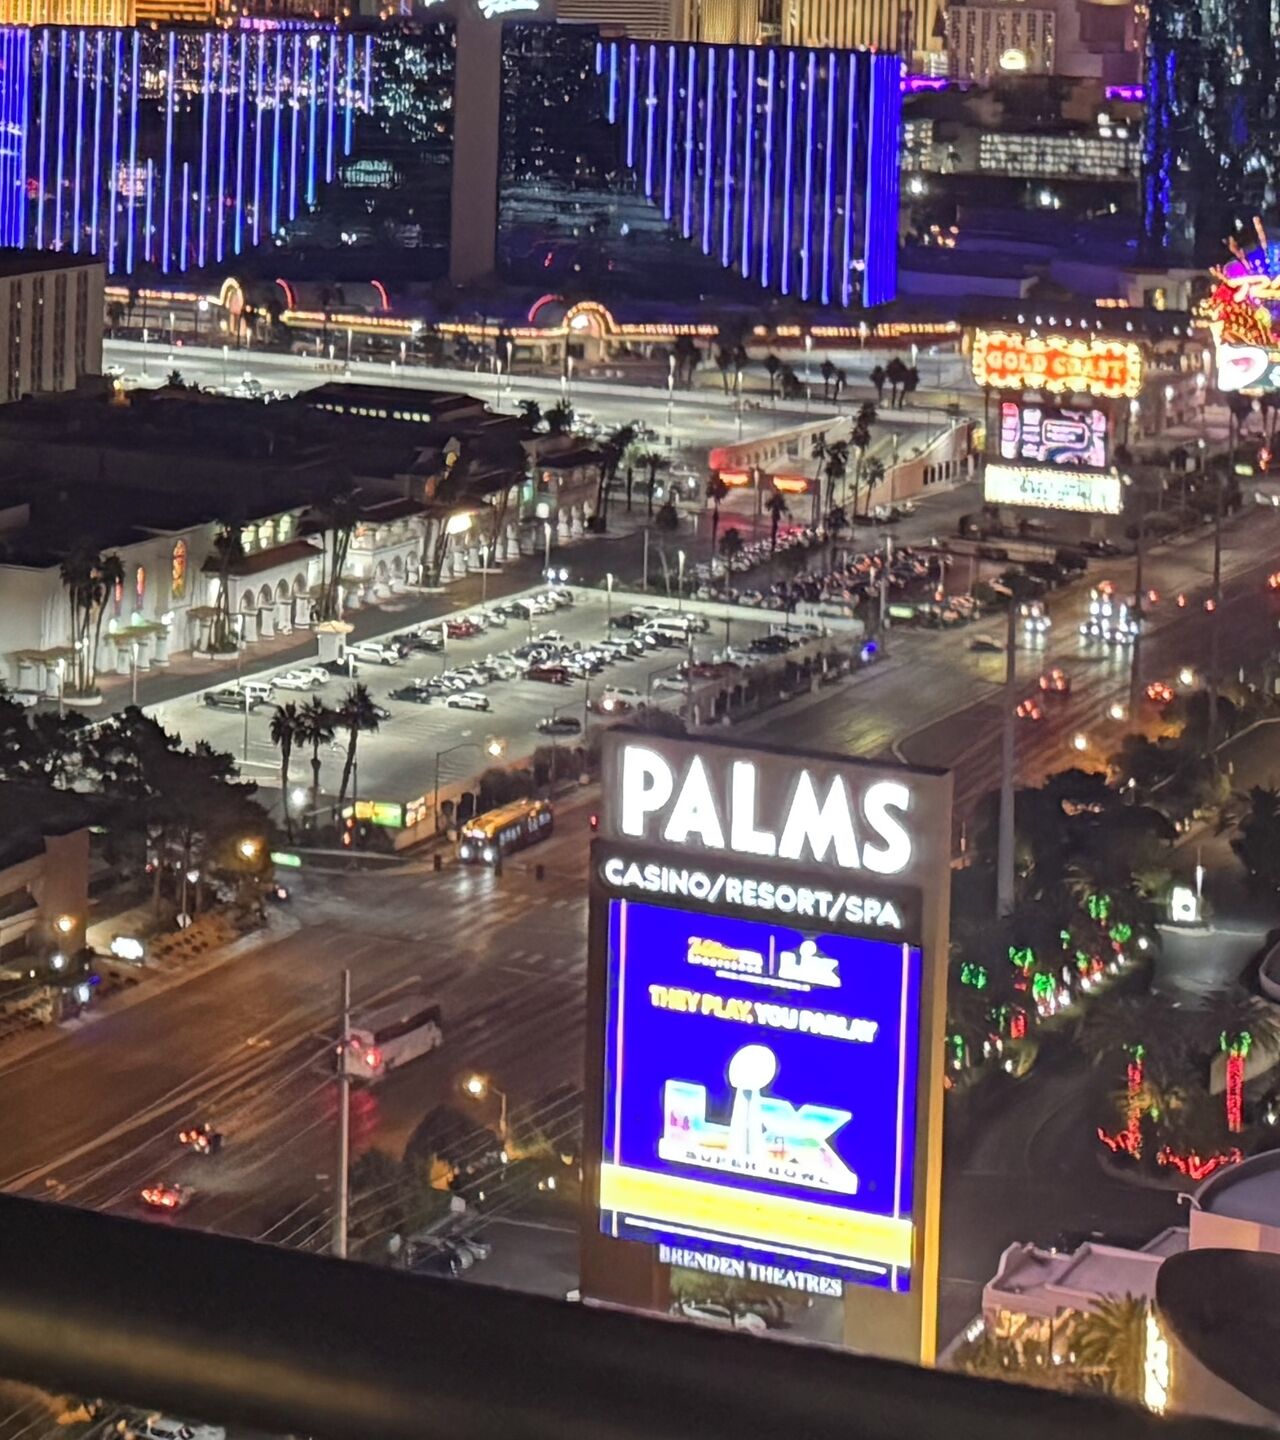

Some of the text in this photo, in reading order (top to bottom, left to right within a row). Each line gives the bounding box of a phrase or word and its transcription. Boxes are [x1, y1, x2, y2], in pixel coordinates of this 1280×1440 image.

[986, 350, 1122, 379] GOLD COAST
[620, 745, 913, 874] PALMS
[648, 983, 702, 1013] THEY
[754, 1001, 799, 1030] YOU
[659, 1243, 843, 1297] BRENDEN THEATRES
